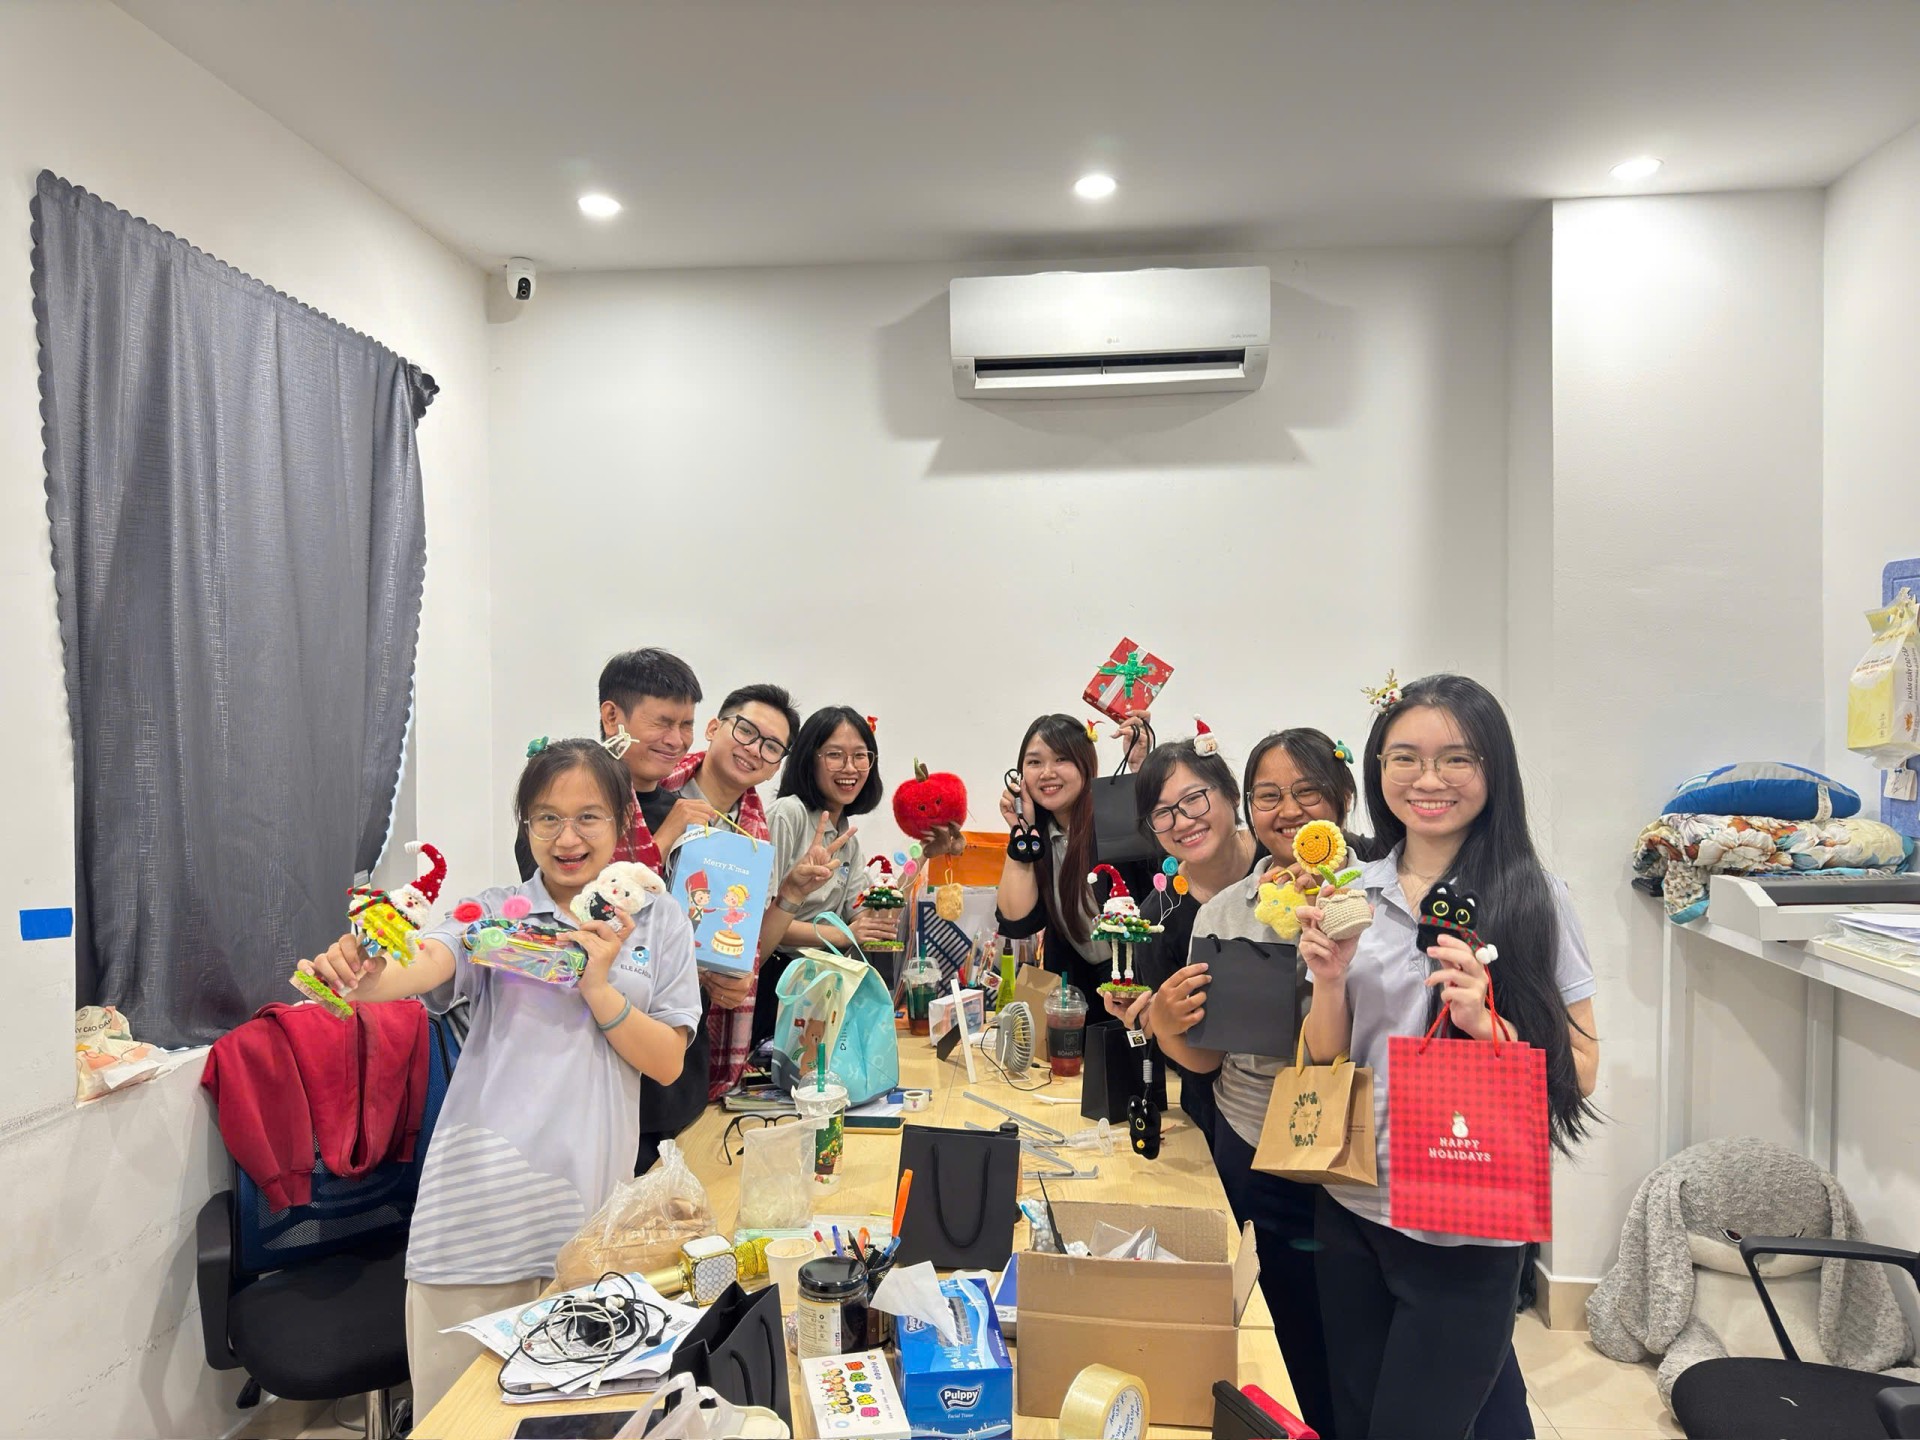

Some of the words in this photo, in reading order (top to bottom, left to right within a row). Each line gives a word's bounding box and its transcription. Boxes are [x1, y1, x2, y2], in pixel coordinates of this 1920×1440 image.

[703, 857, 727, 871] Merry
[727, 863, 750, 876] X'mas
[83, 1025, 97, 1033] CAO
[1439, 1136, 1480, 1150] HAPPY
[1428, 1147, 1492, 1163] HOLIDAYS
[944, 1387, 979, 1401] Pulppy
